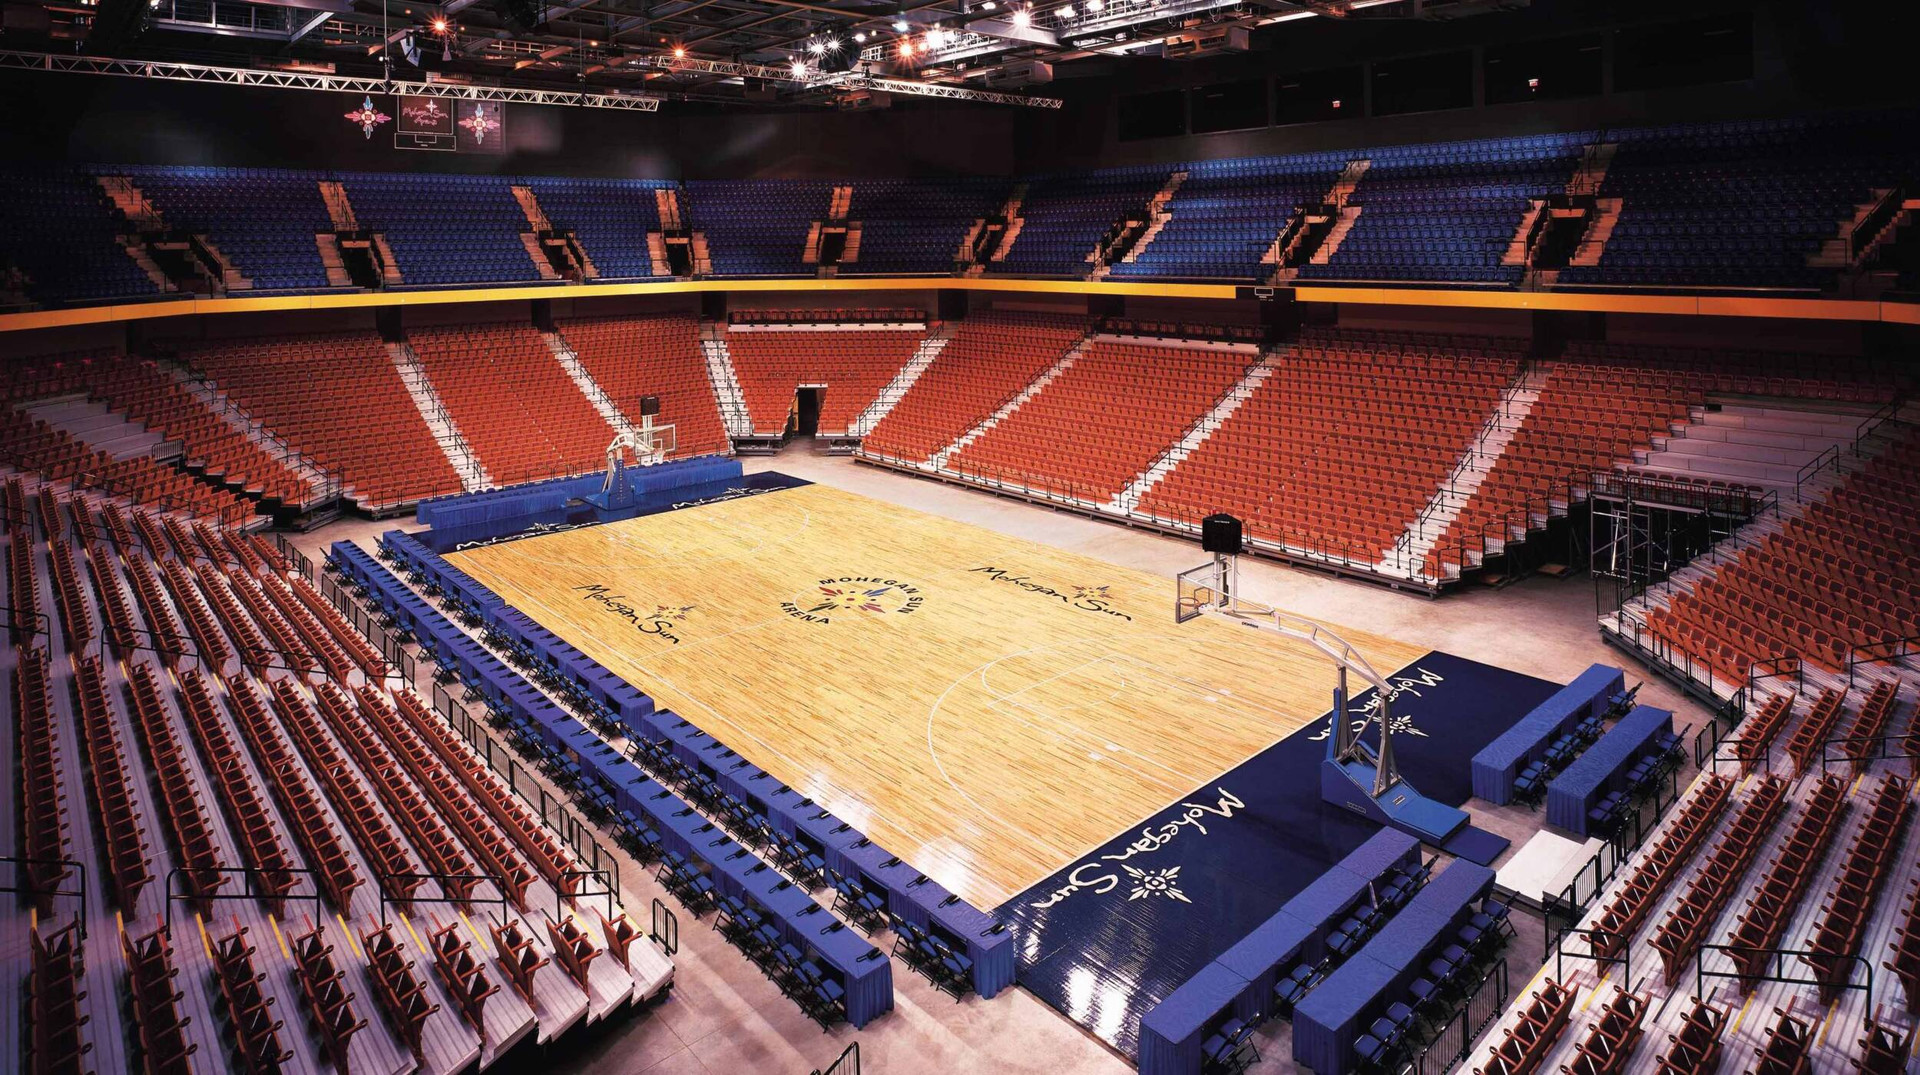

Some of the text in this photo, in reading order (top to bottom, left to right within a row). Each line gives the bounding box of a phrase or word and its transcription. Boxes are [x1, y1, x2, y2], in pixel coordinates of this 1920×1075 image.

[572, 584, 680, 644] Mohegan Sun
[780, 601, 830, 625] ARENA
[819, 576, 924, 614] MOHEGAN SUN
[968, 566, 1132, 621] Mohegan Sun
[1030, 786, 1246, 908] Mohegan Sun
